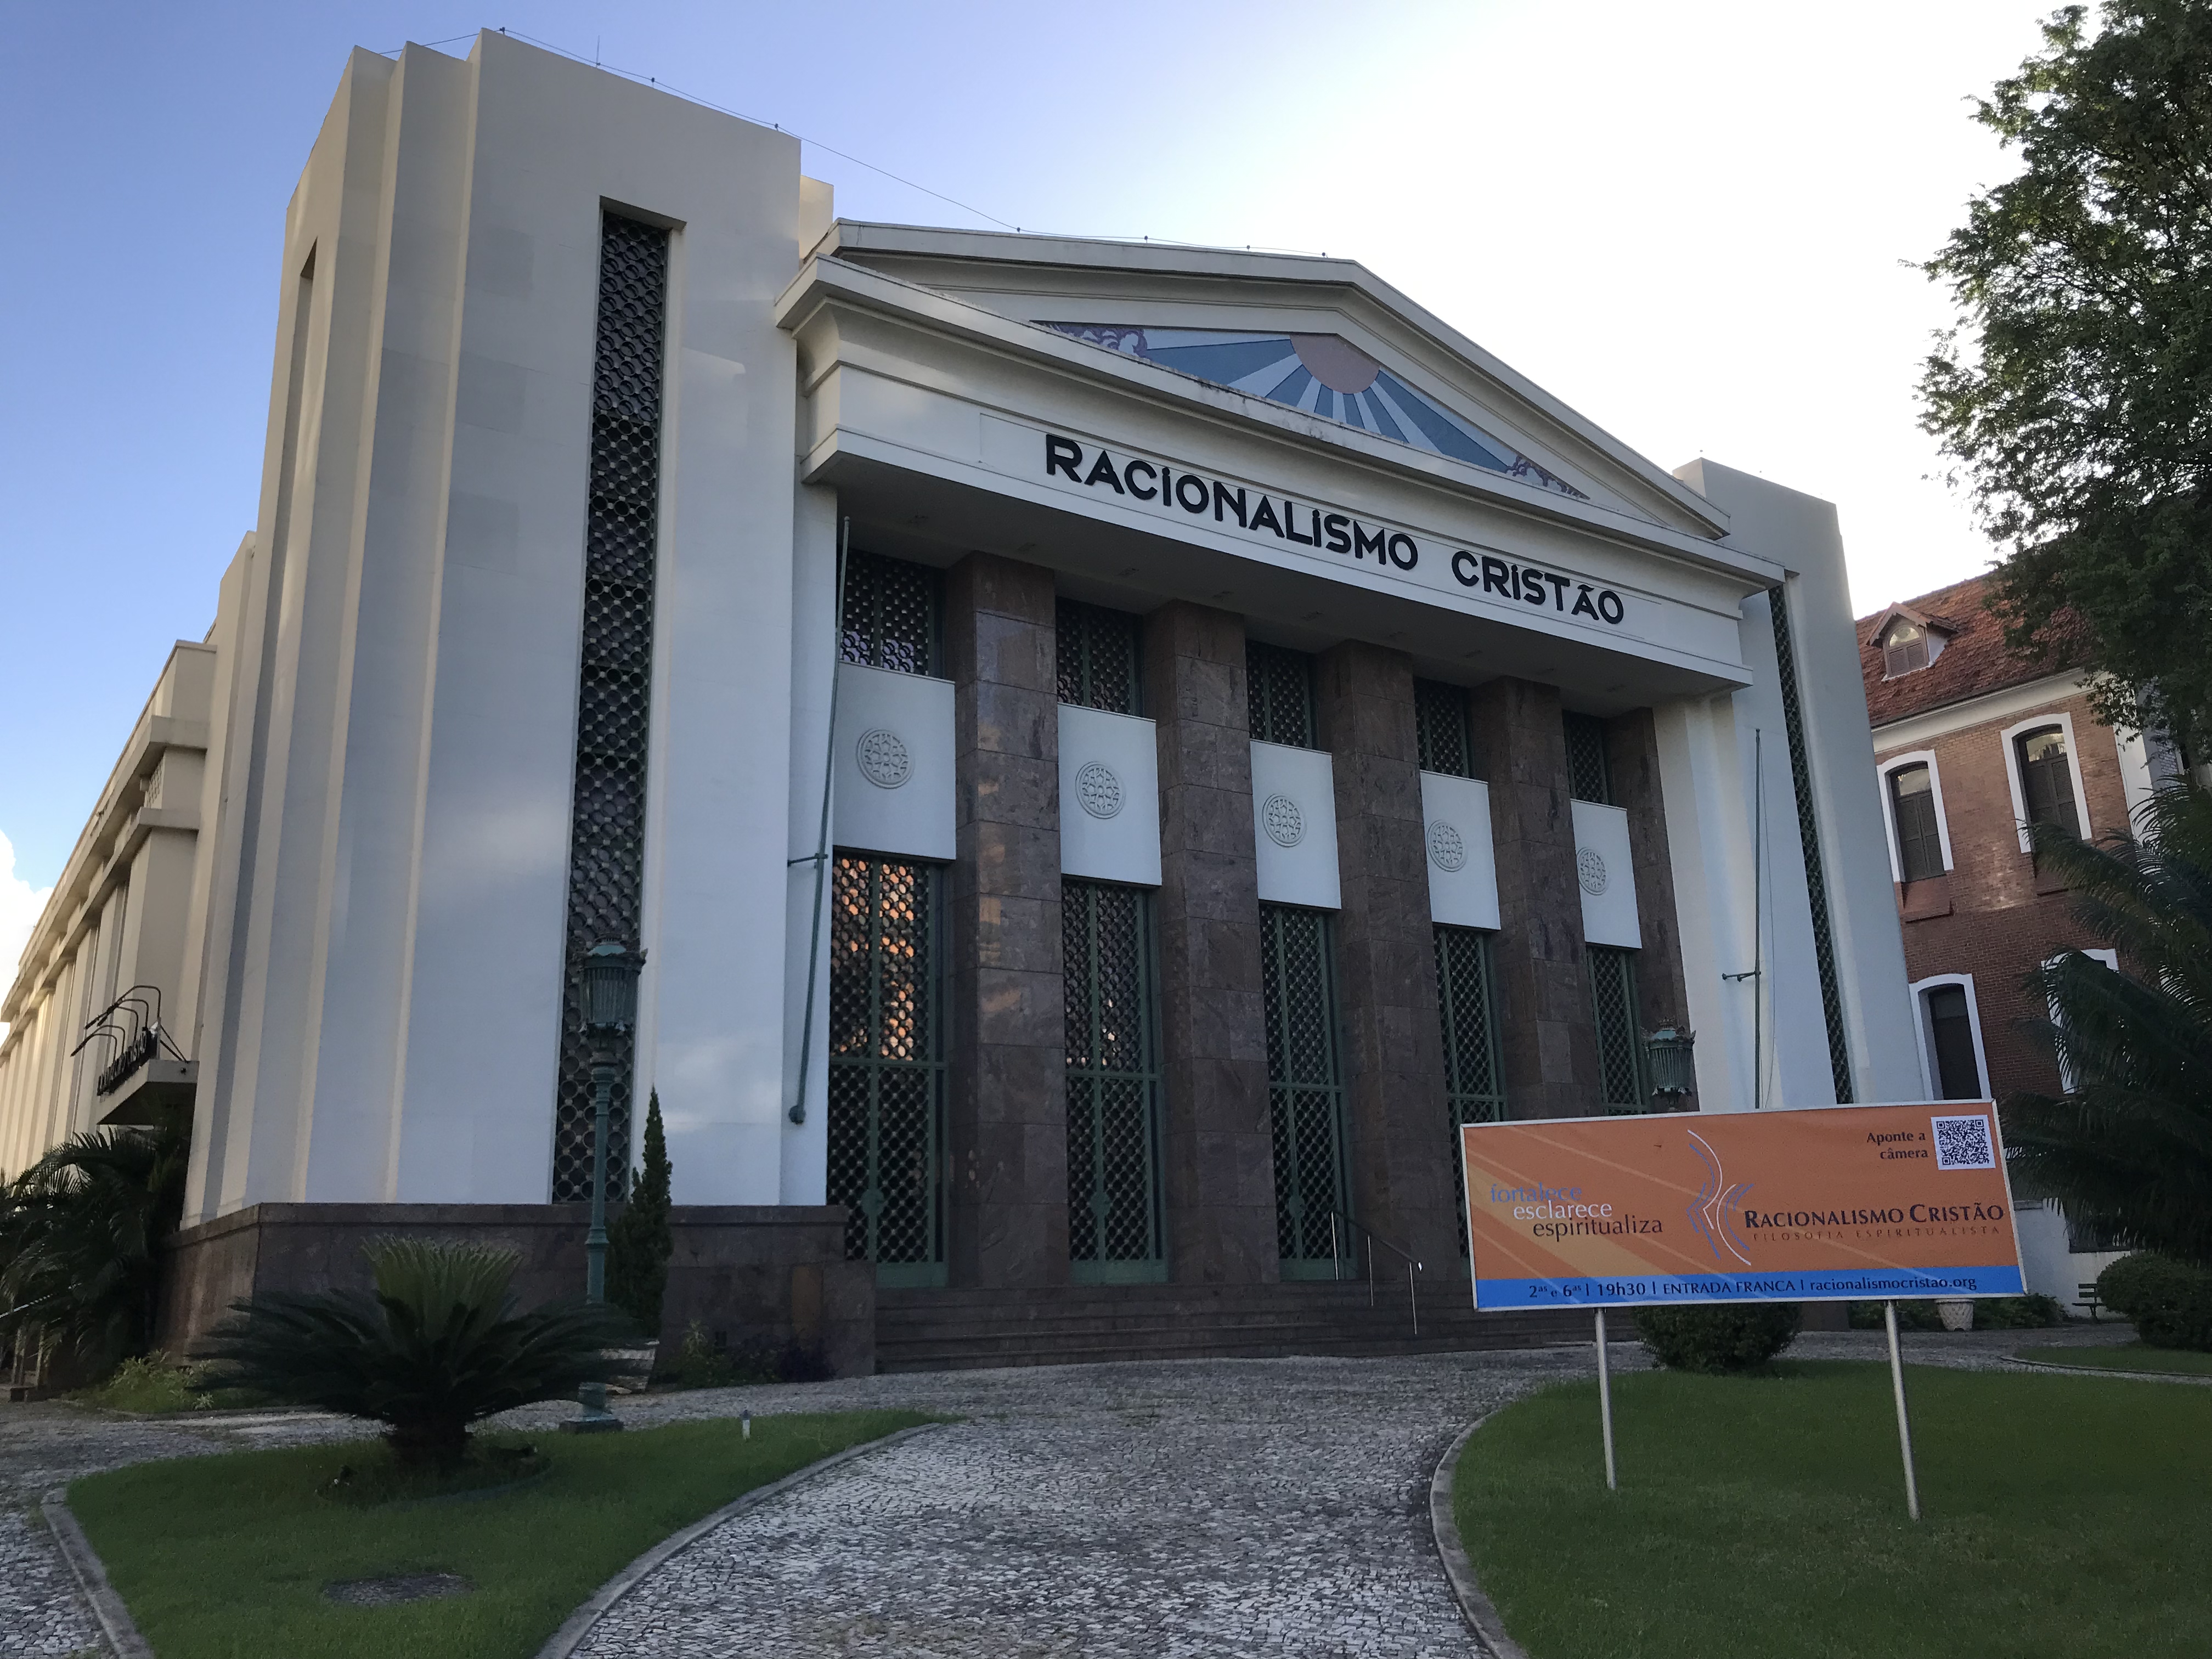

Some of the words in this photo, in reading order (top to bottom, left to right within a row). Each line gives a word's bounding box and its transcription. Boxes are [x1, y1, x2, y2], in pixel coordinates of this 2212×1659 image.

[1866, 1132, 1914, 1146] Aponte
[1918, 1132, 1926, 1141] a
[1880, 1147, 1929, 1160] câmera
[1490, 1182, 1582, 1203] fortalece
[1513, 1200, 1612, 1220] esclarece
[1744, 1207, 1904, 1228] RACIONALISMO
[1909, 1202, 2004, 1223] CRISTÃO
[1533, 1214, 1663, 1242] espiritualiza
[1856, 1226, 2000, 1238] ESPIRITUALISTA
[1597, 1282, 1646, 1296] 19h30
[1662, 1282, 1732, 1295] ENTRADA
[1736, 1280, 1796, 1293] FRANCA
[1810, 1277, 1977, 1291] racionalismocristao.org
